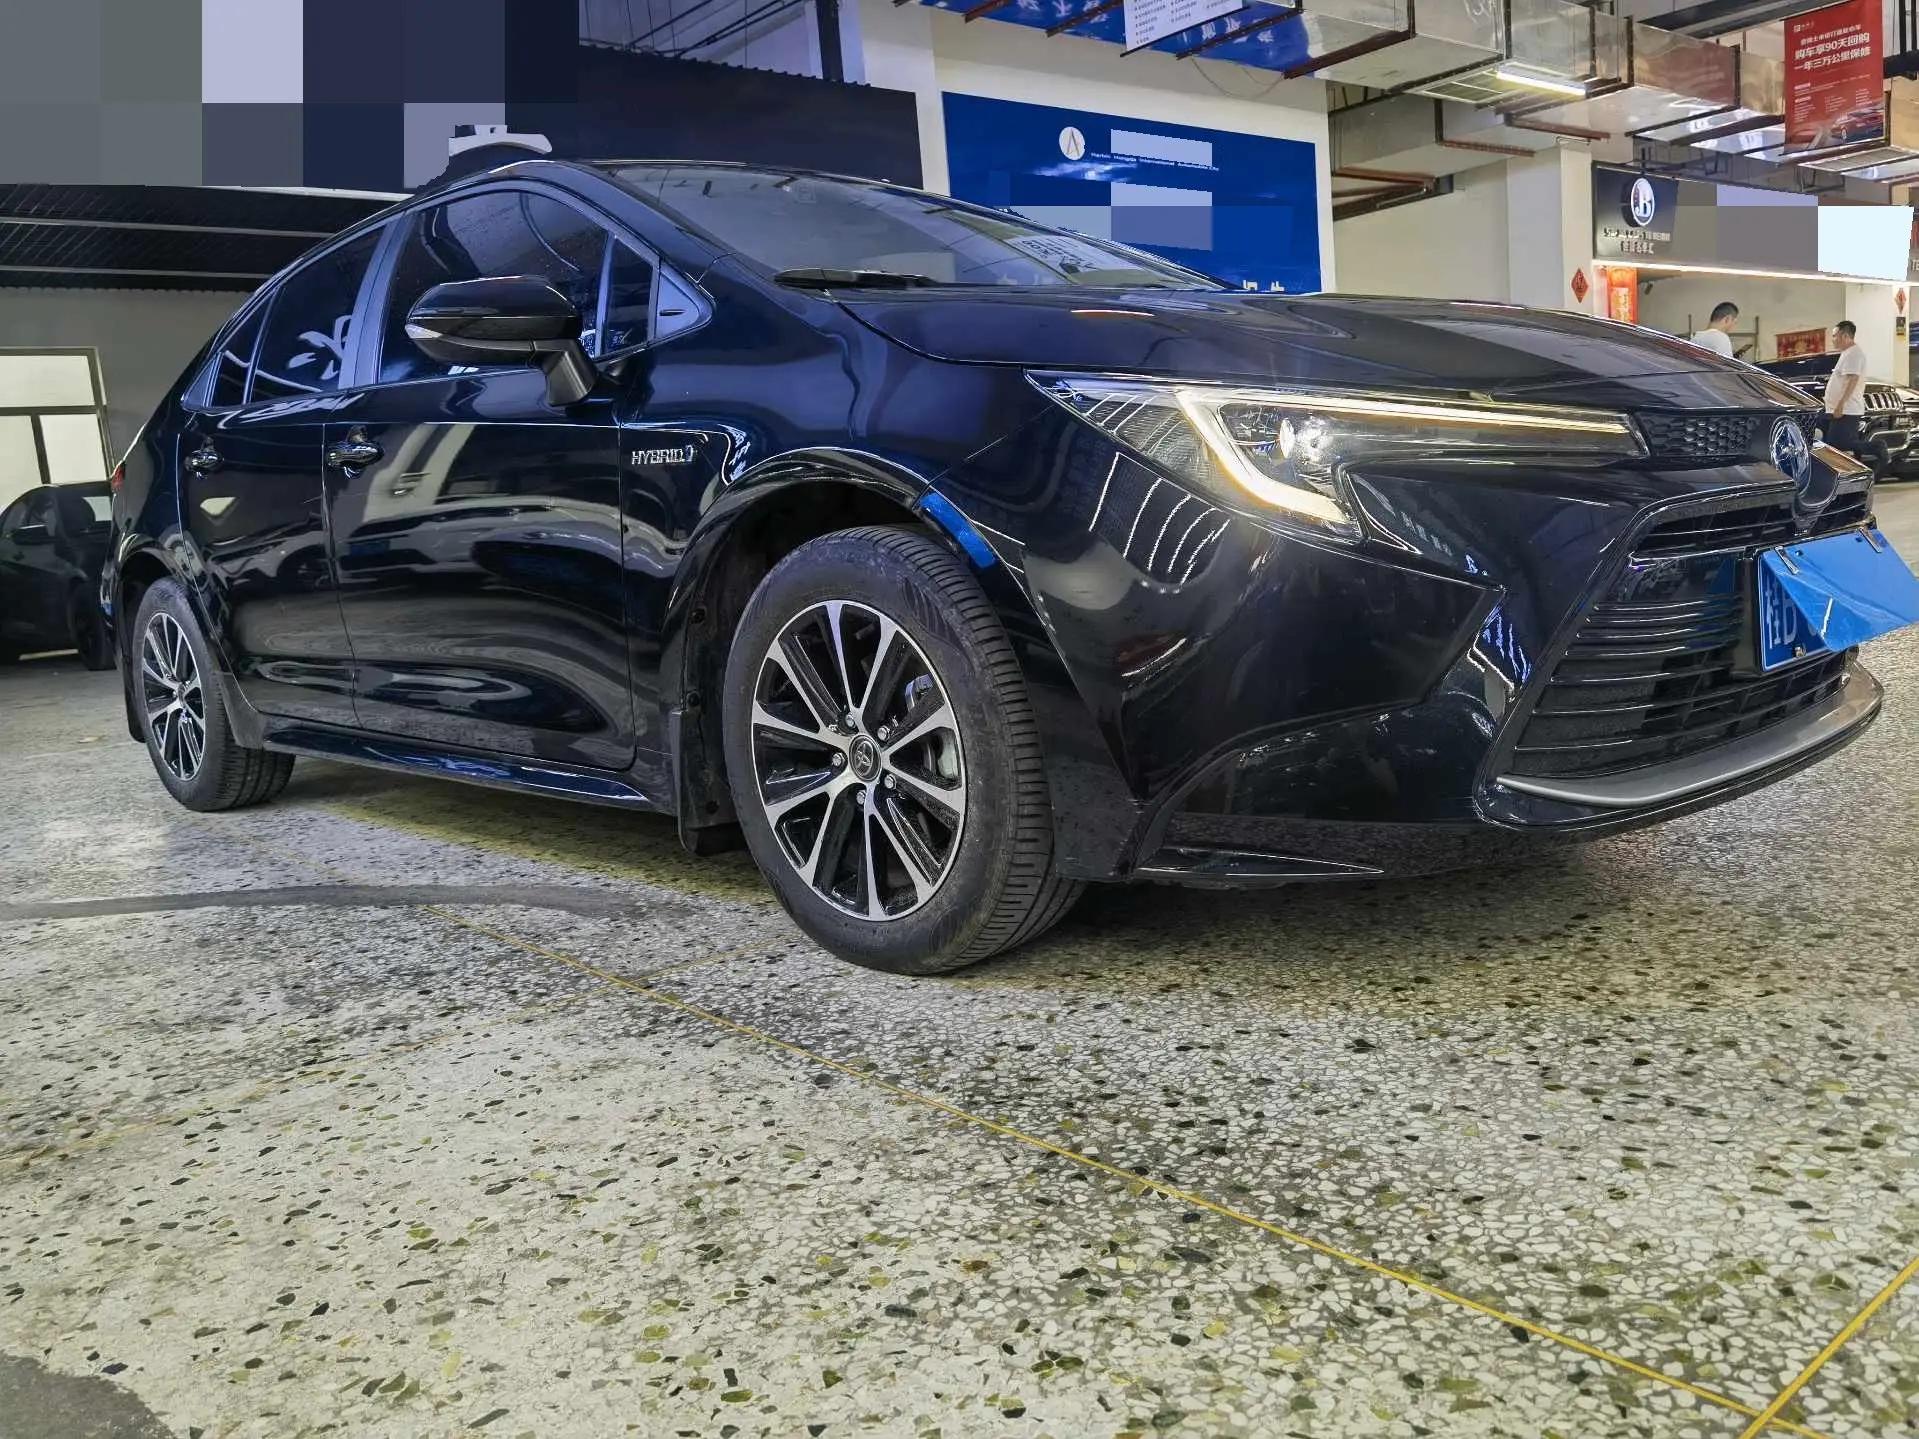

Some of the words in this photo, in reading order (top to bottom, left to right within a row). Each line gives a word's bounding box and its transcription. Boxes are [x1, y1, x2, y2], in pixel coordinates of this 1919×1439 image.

[1795, 32, 1870, 60] 购车享90天回购
[1794, 47, 1871, 71] 一年三万公里保修
[631, 448, 685, 465] HYBRID
